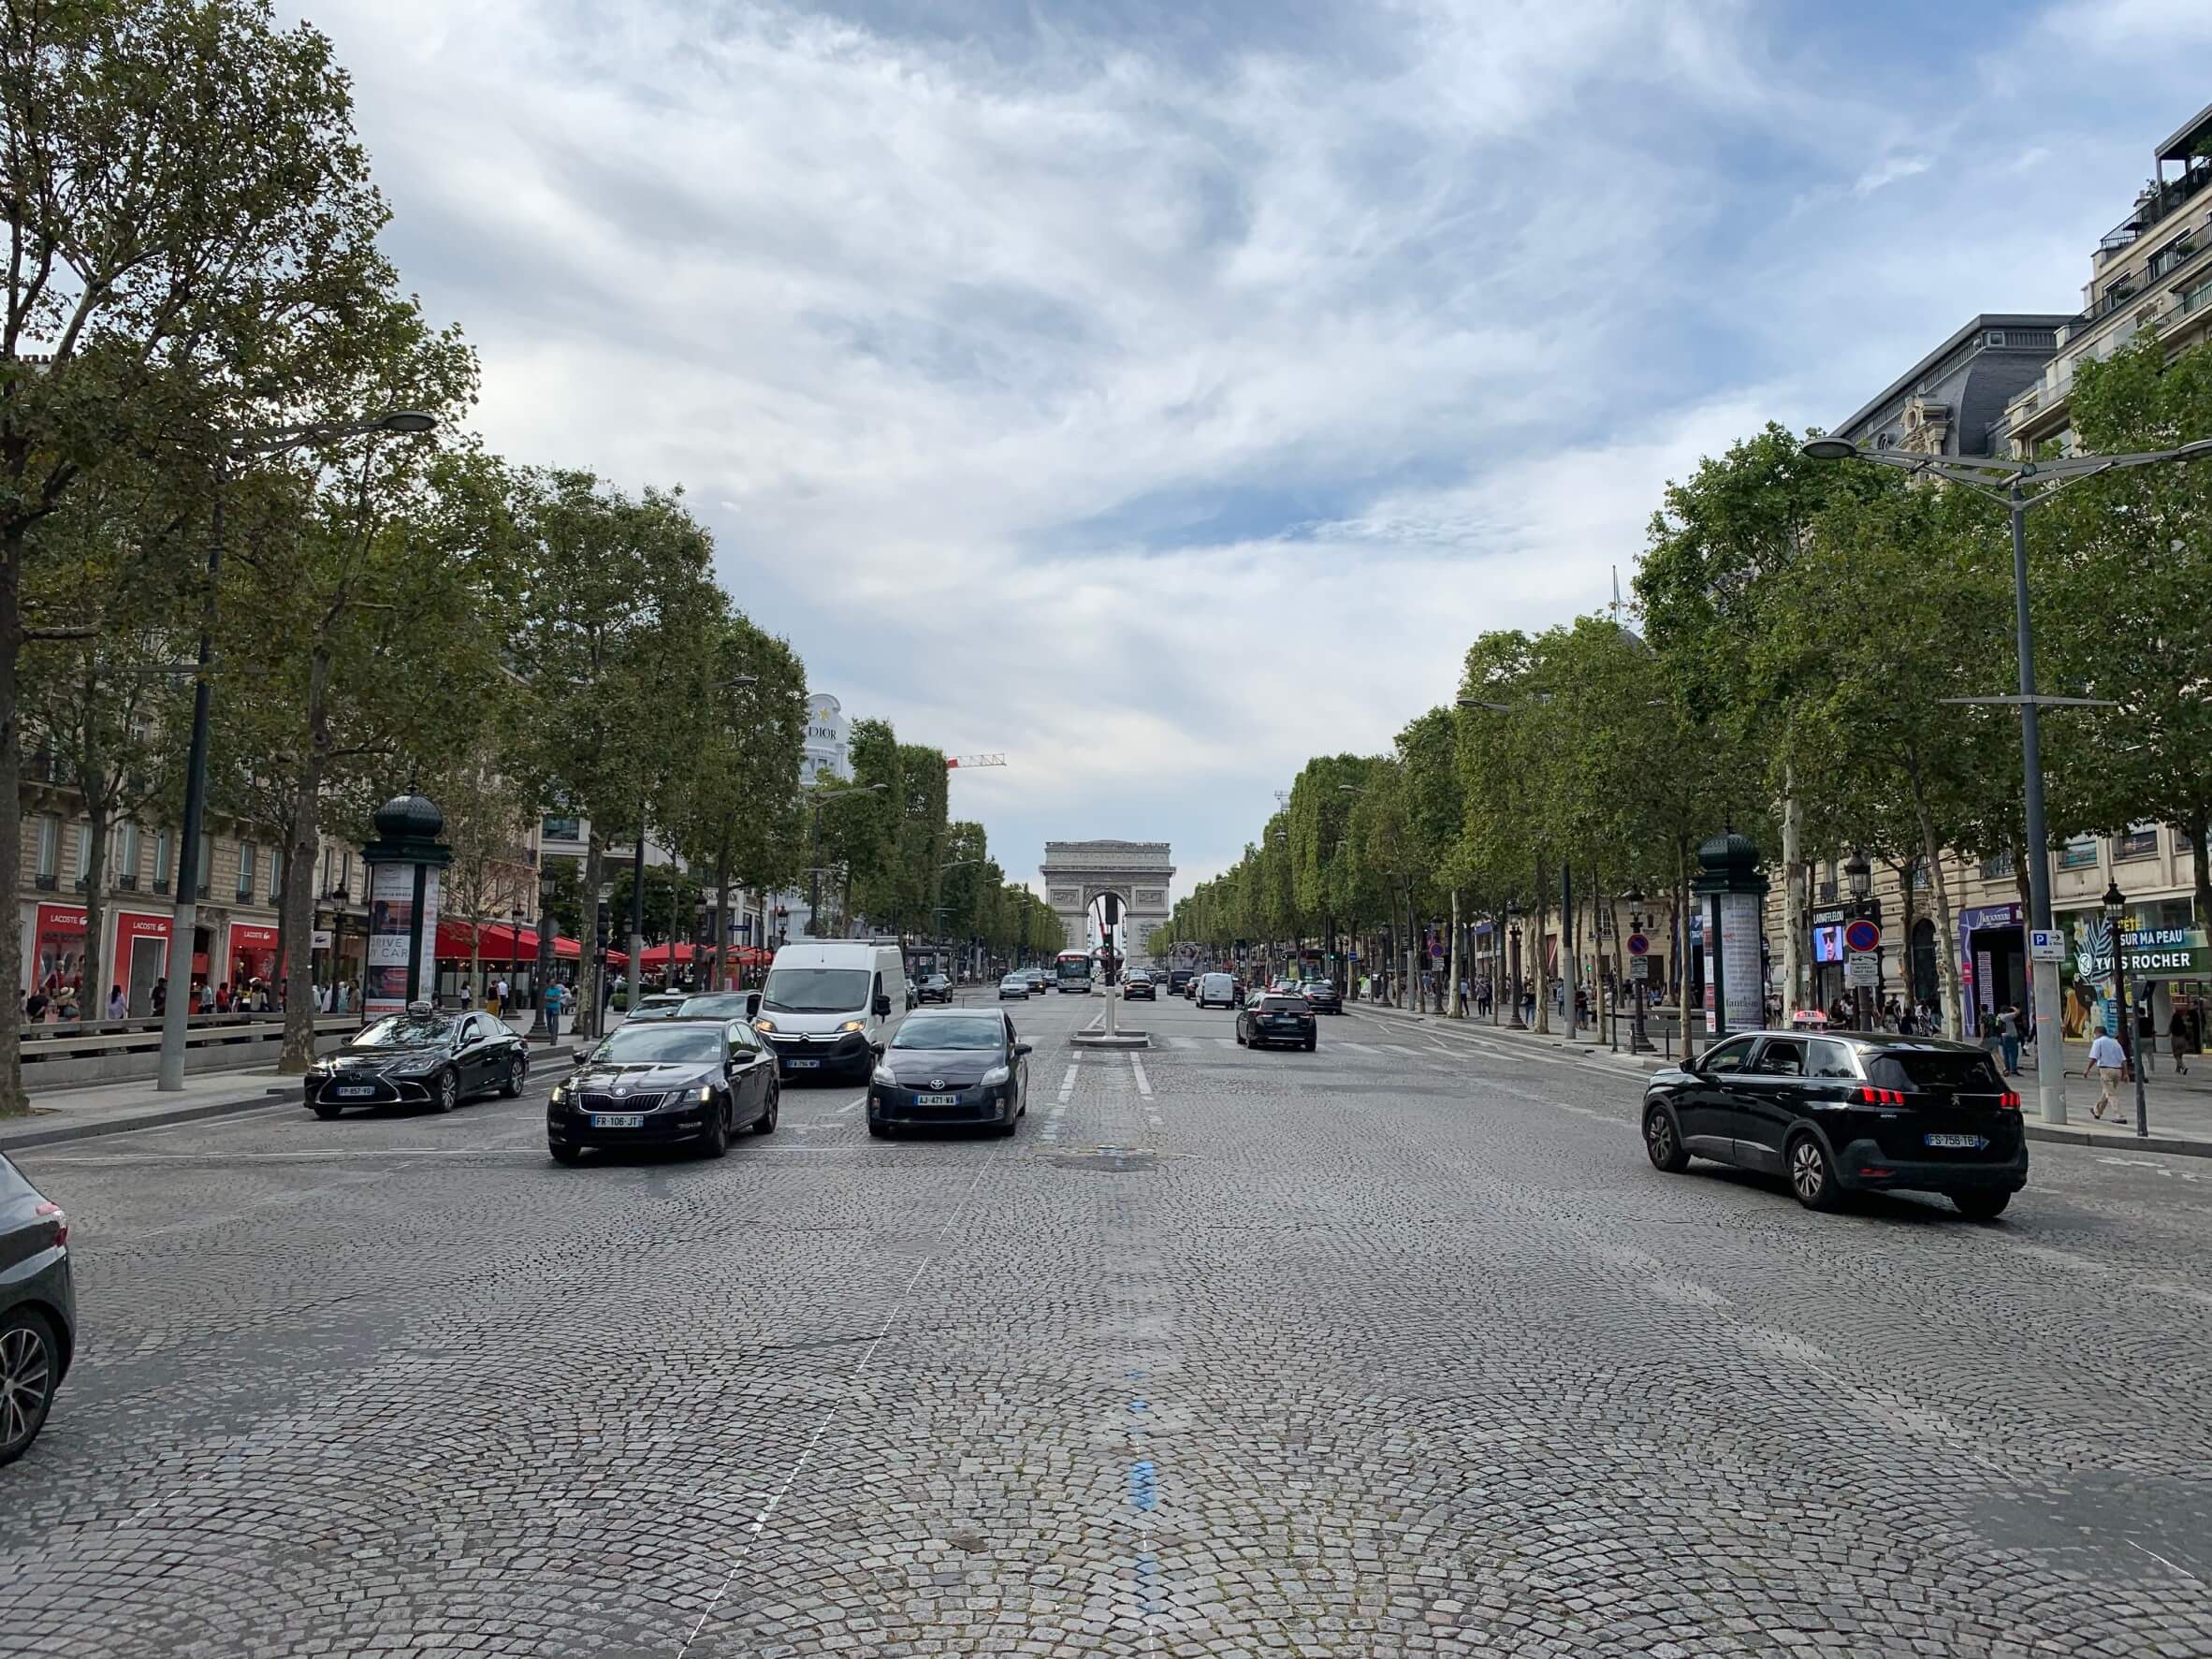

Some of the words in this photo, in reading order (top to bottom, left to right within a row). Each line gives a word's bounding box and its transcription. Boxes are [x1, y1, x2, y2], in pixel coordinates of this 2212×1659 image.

[808, 726, 837, 739] DIOR
[51, 915, 78, 924] LACOSTE
[133, 922, 157, 930] LACOSTE
[243, 930, 263, 939] LACOSTE
[2120, 934, 2138, 945] SUR
[2140, 932, 2154, 944] MA
[2156, 930, 2183, 943] PEAU
[382, 948, 408, 958] CAR
[2096, 957, 2128, 970] YVS
[2132, 953, 2190, 969] ROCHER
[596, 1116, 637, 1127] FR-106-JT
